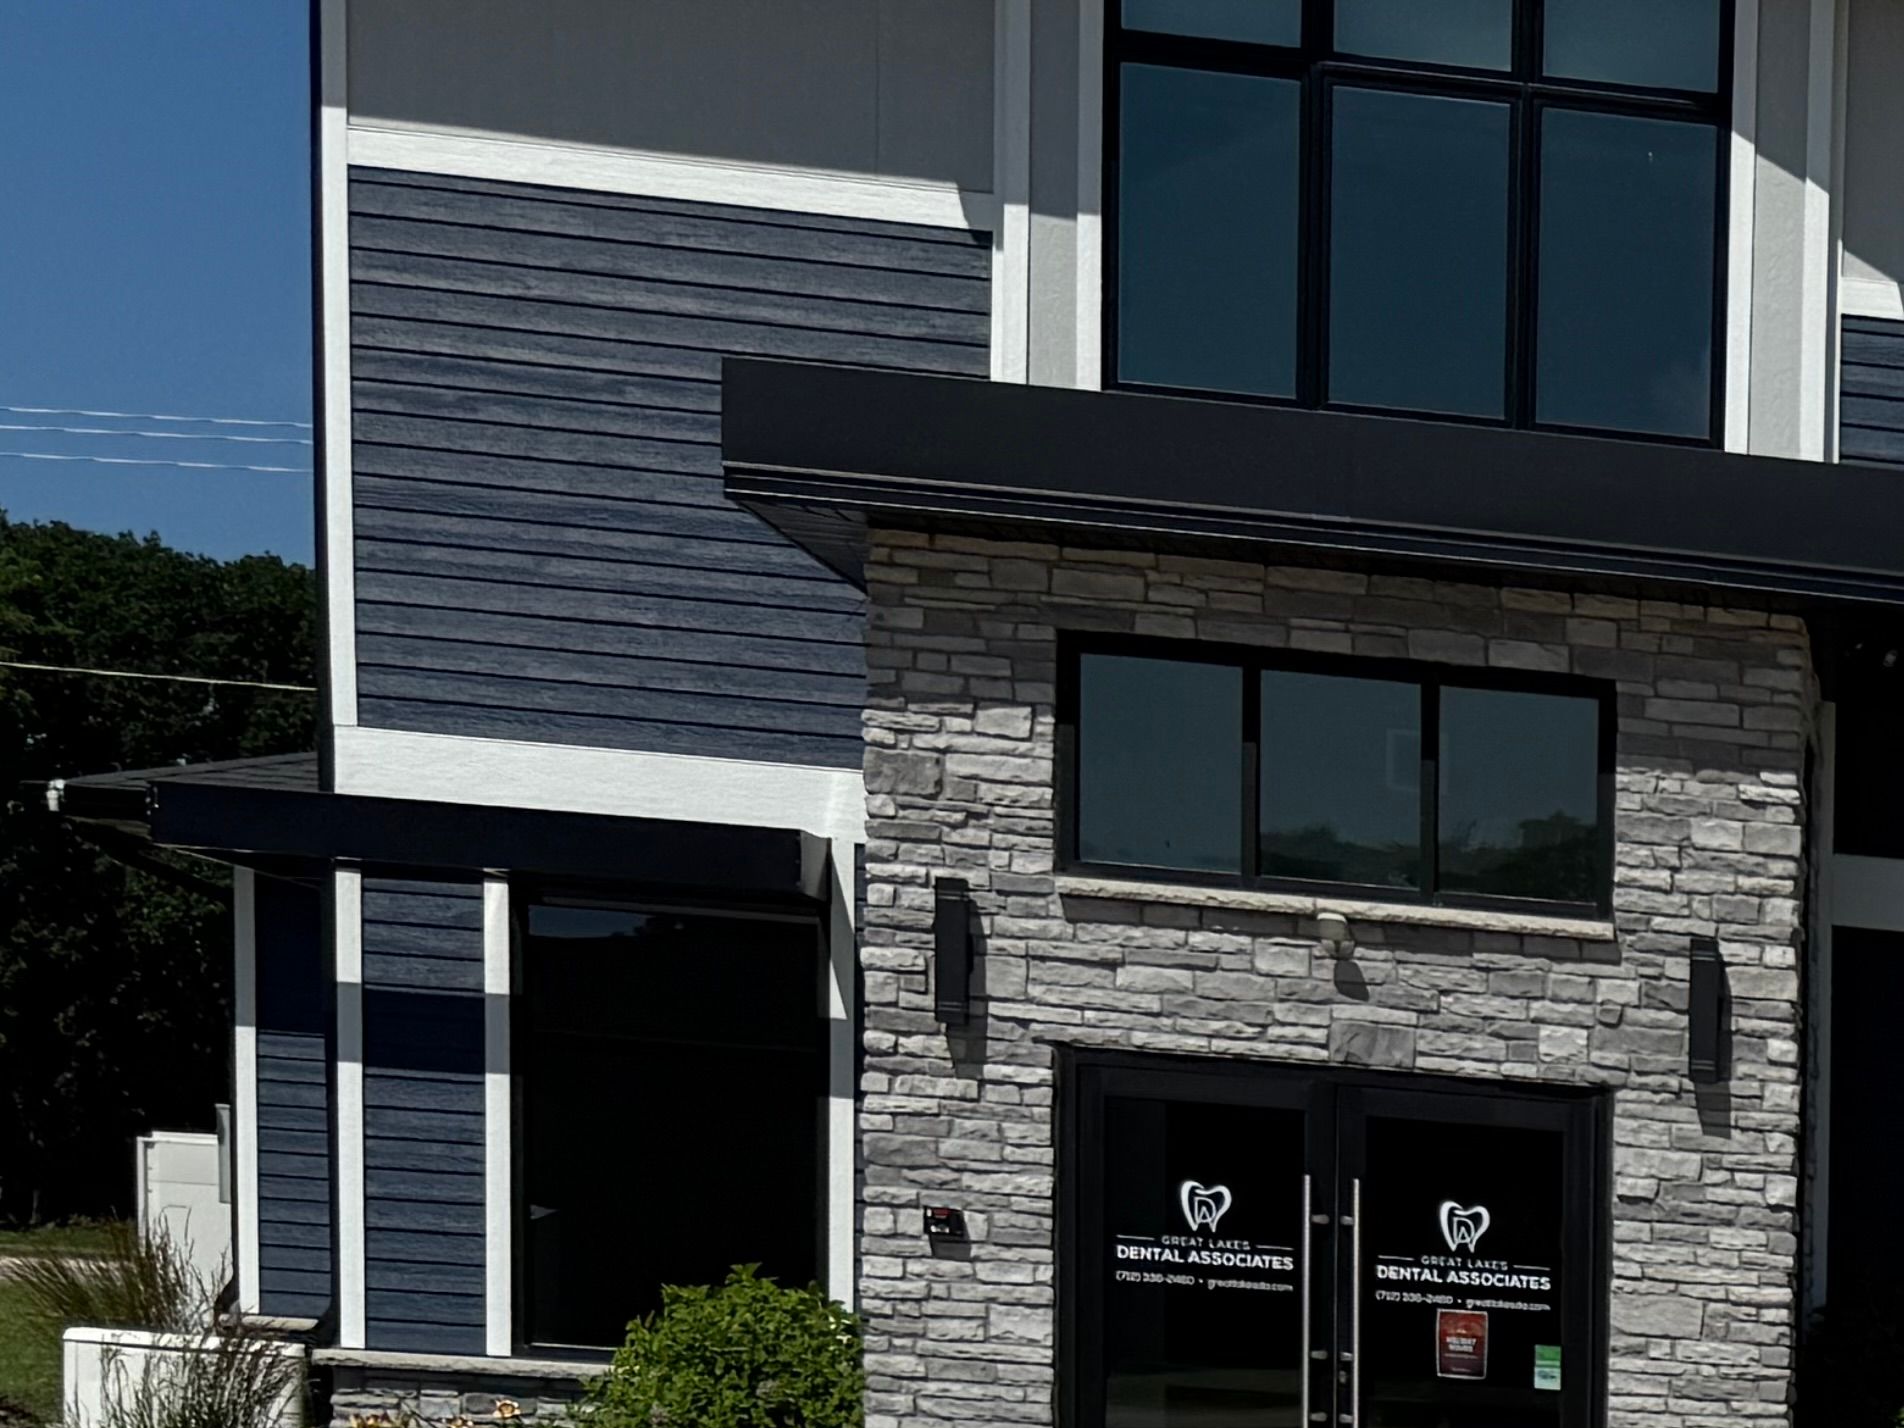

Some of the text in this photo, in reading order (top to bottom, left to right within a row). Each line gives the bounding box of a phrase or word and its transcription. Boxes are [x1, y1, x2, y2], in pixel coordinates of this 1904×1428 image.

[1161, 1235, 1251, 1250] GREAT LAKES
[1116, 1245, 1294, 1270] DENTAL ASSOCIATES
[1420, 1255, 1508, 1271] GREAT LAKES
[1376, 1265, 1551, 1290] DENTAL ASSOCIATES
